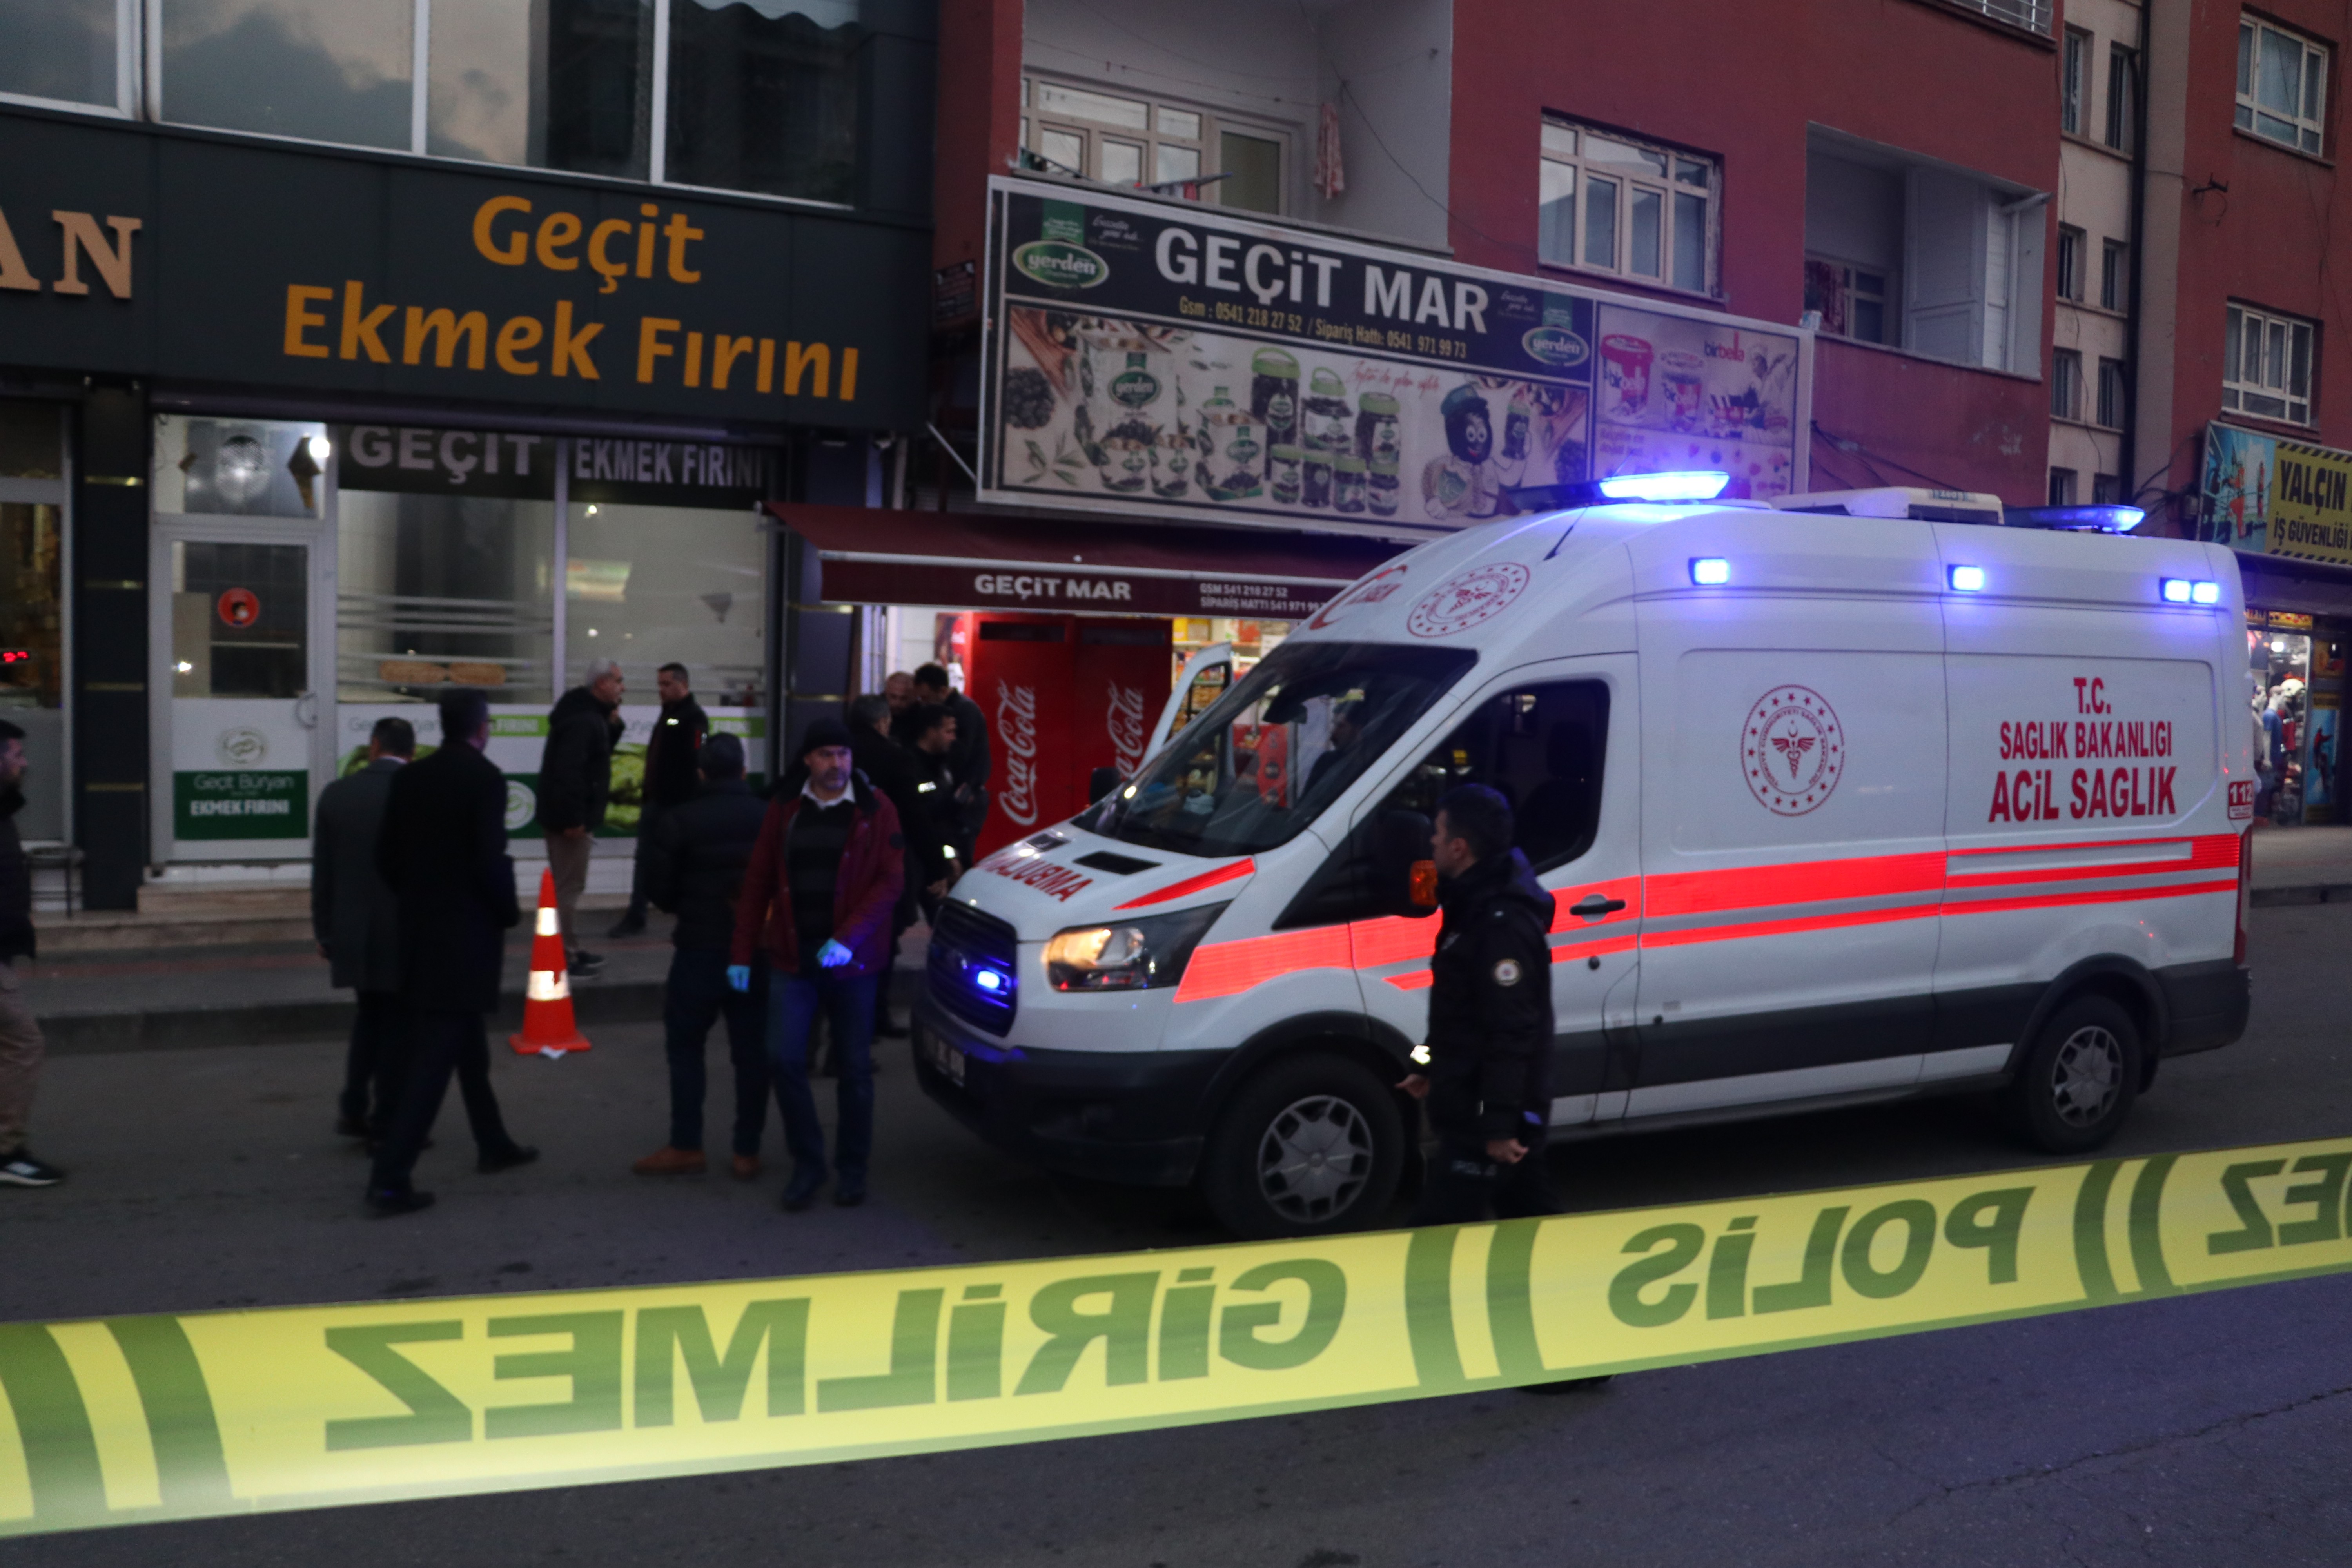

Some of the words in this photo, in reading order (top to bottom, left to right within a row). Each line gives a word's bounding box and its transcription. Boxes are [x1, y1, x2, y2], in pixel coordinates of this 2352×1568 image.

[472, 195, 704, 294] Geçit
[1364, 264, 1490, 334] MAR
[283, 279, 605, 380] Ekmek
[636, 316, 859, 401] Fırını
[1179, 295, 1205, 316] Gsm
[1216, 301, 1243, 323] 0541
[1247, 307, 1268, 327] 218
[1271, 311, 1284, 328] 27
[1288, 314, 1302, 332] 52
[1315, 318, 1353, 345] Sipariş
[1387, 330, 1412, 350] 0541
[1417, 335, 1436, 354] 971
[1439, 338, 1451, 356] 99
[1454, 341, 1467, 359] 73
[575, 437, 674, 484] EKMEK
[2280, 459, 2347, 516] YALÇIN
[2274, 511, 2286, 546] İŞ
[2288, 514, 2349, 550] GÜVENLİĞİ
[1065, 579, 1132, 600] MAR
[2074, 677, 2111, 714] T.C.
[2076, 721, 2172, 759] BAKANLIGI
[190, 799, 242, 816] EKMEK
[2230, 783, 2252, 804] 112
